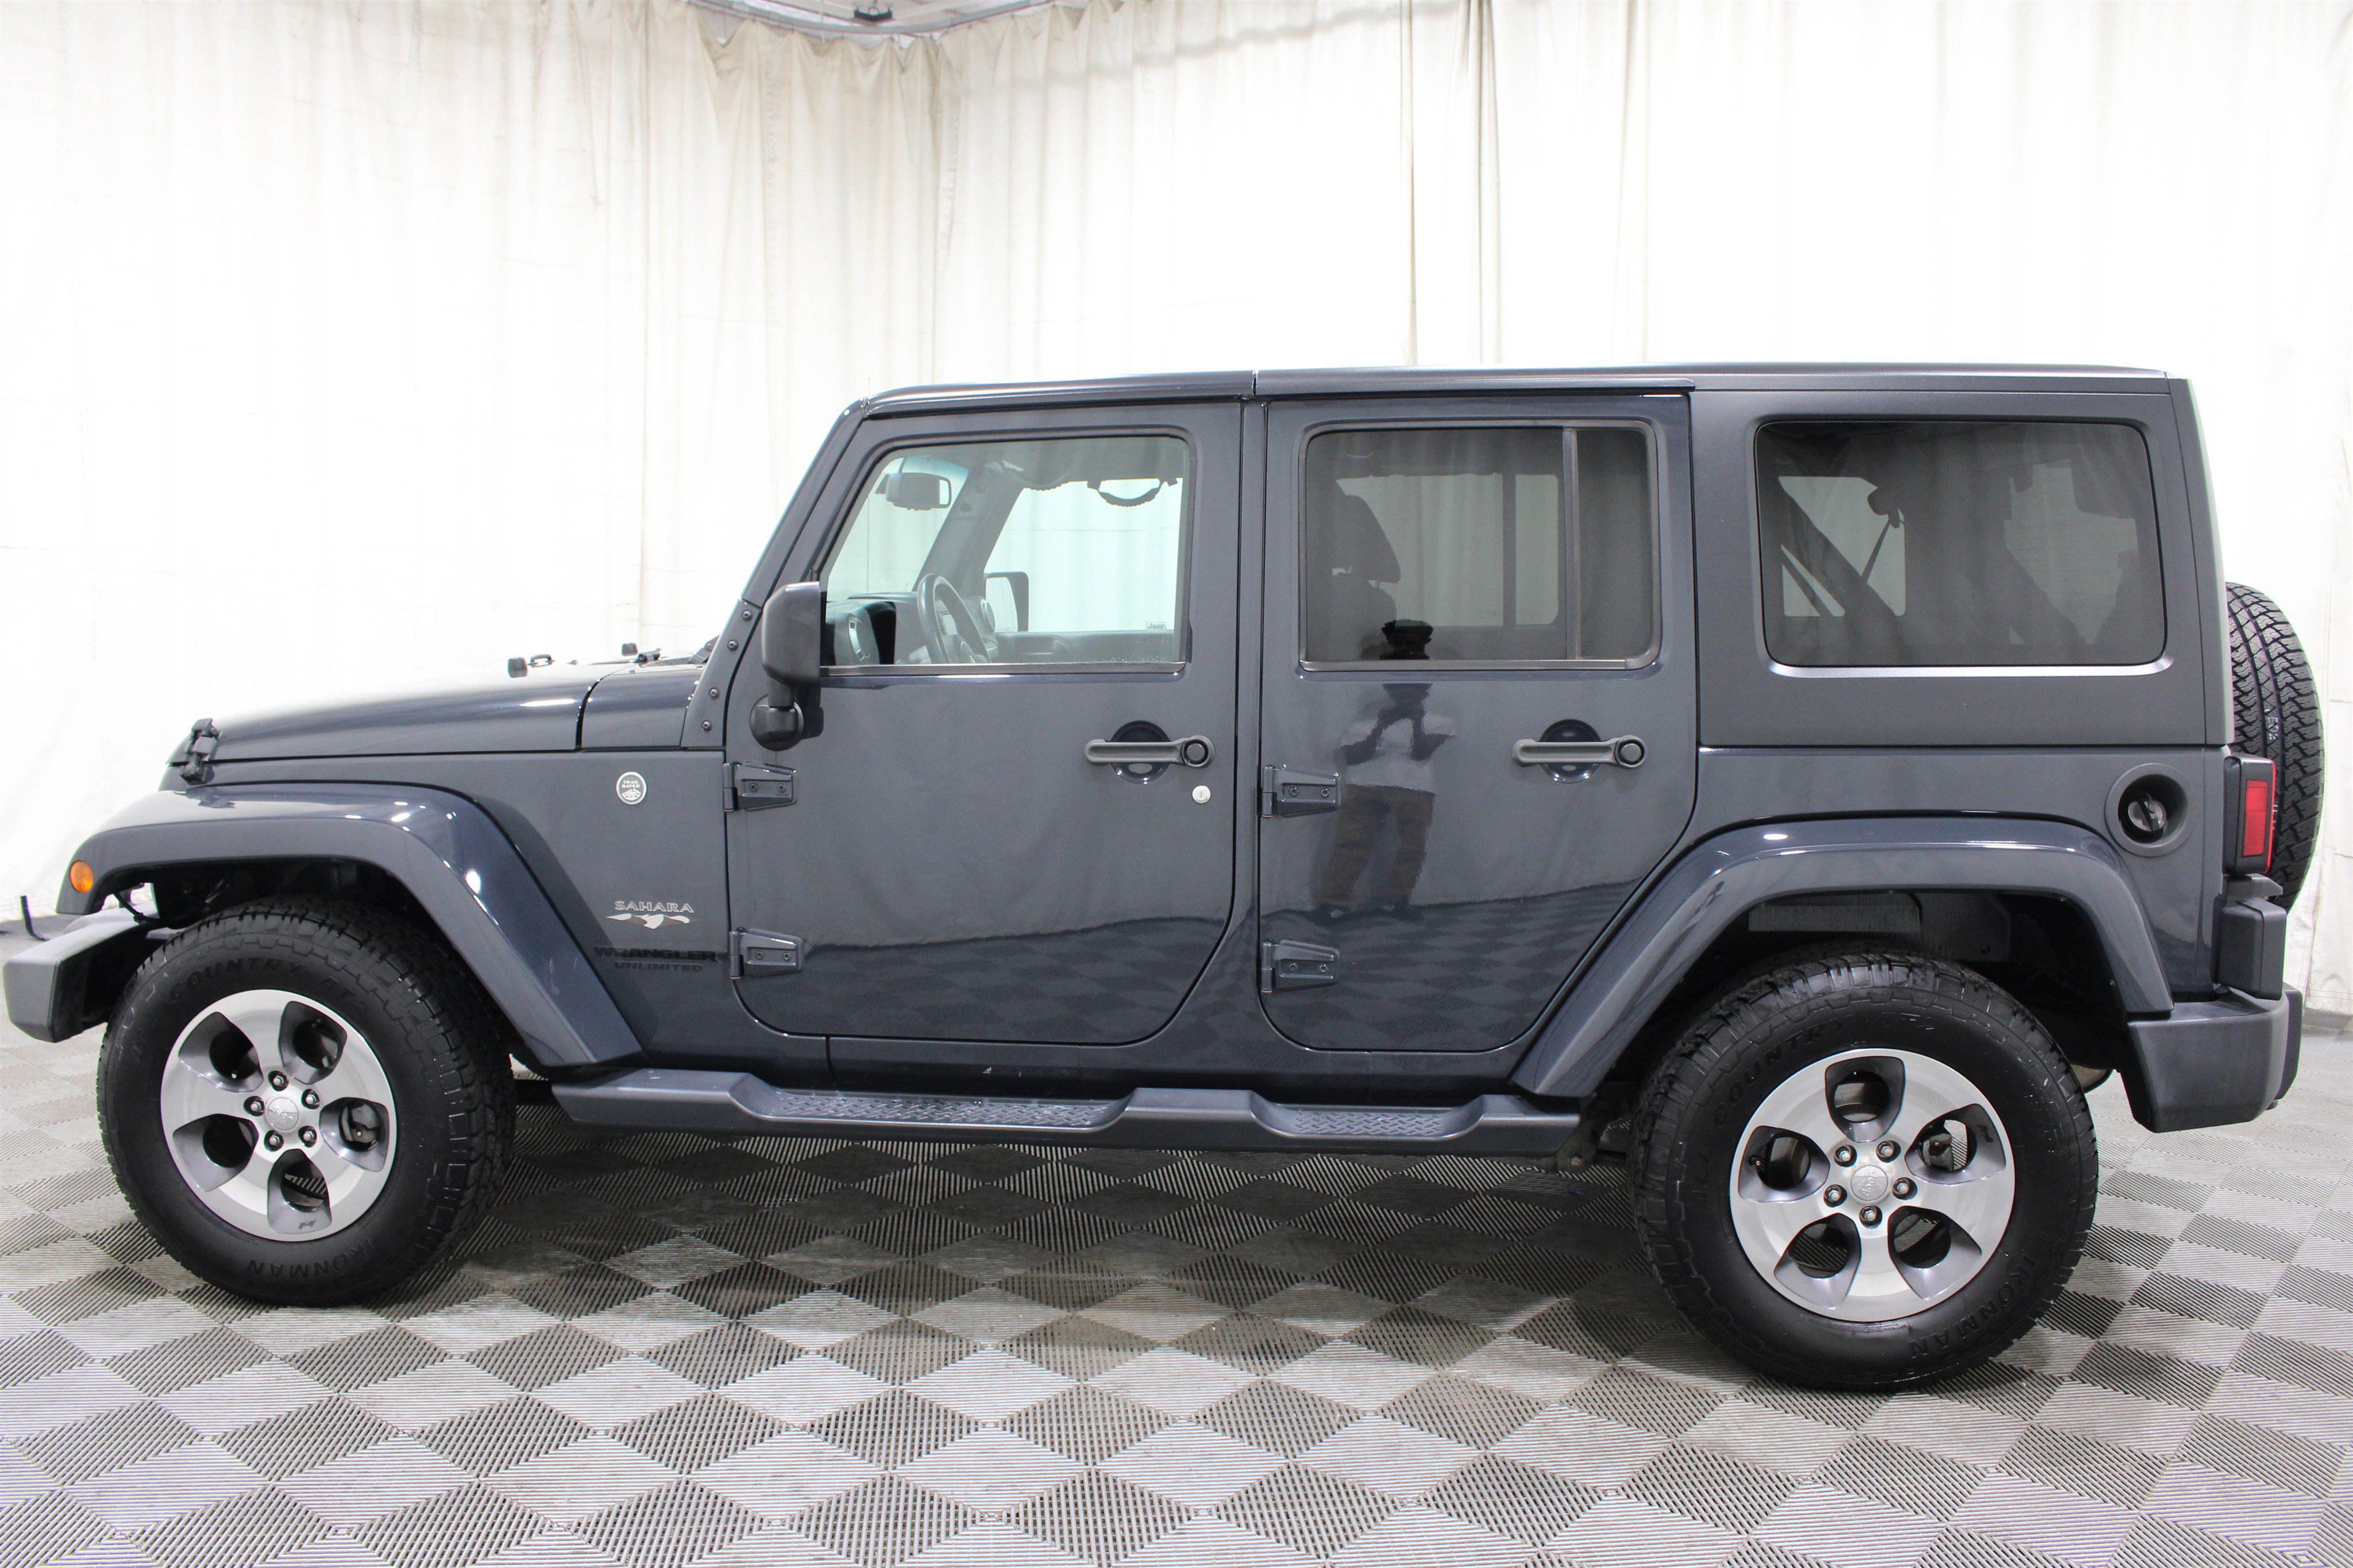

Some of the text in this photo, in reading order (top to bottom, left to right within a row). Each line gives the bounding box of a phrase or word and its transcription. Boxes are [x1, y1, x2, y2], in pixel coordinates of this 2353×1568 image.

[615, 900, 695, 913] SAHARA
[593, 946, 720, 963] WRANGLER
[614, 961, 704, 972] UNLIMITED
[170, 957, 303, 1002] COUNTRY
[1714, 1014, 1853, 1129] COUNTRY
[247, 1237, 376, 1279] IRONMAN
[1909, 1255, 2037, 1360] IRONMAN
